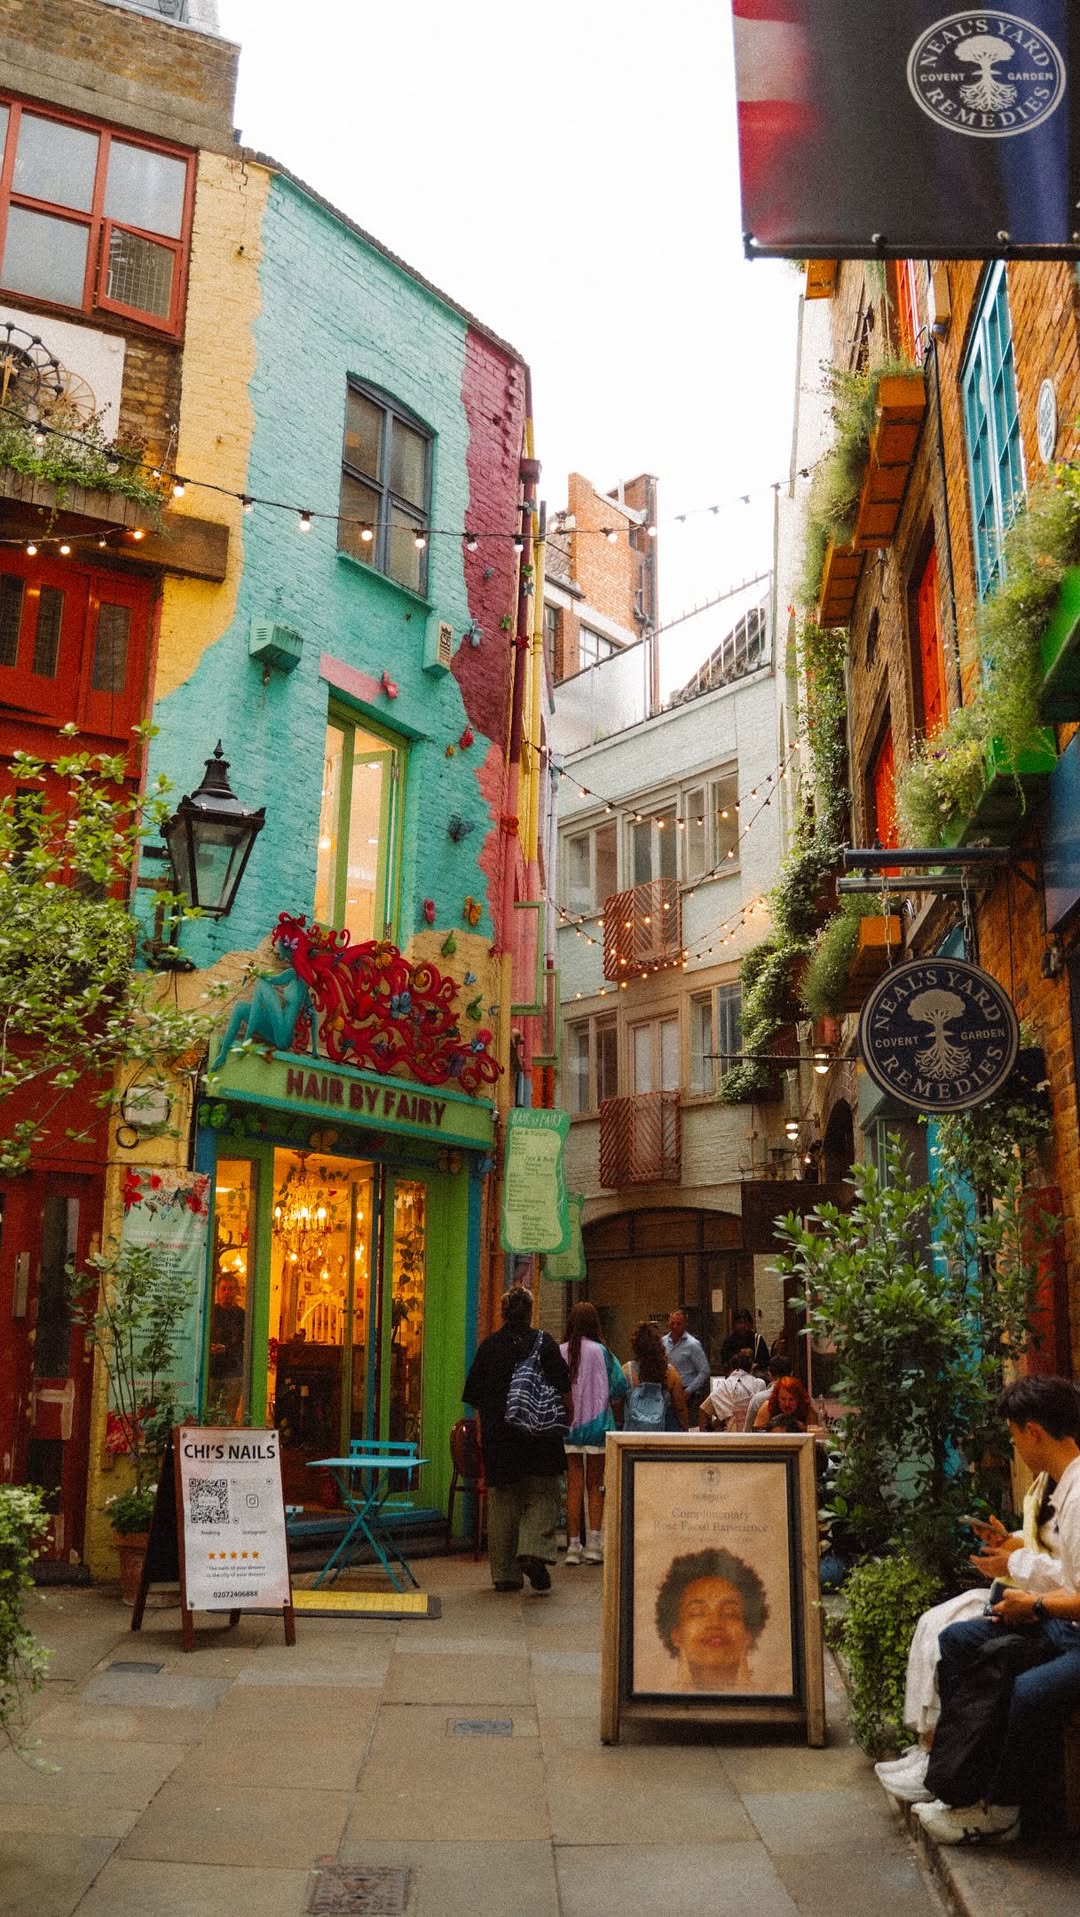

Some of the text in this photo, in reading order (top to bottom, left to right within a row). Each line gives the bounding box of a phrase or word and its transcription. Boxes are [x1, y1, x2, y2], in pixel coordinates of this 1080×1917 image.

[919, 19, 1050, 68] NEAL'S YARD
[919, 72, 1054, 82] COVENT GARDEN
[926, 86, 1050, 128] REMEDIES
[873, 969, 1001, 1031] NEAL'S YARD
[874, 1028, 1006, 1048] COVENT GARDEN
[882, 1046, 1004, 1098] REMEDIES
[286, 1068, 447, 1127] HAIR BY FAIRY
[184, 1444, 276, 1459] CHI'S NAILS
